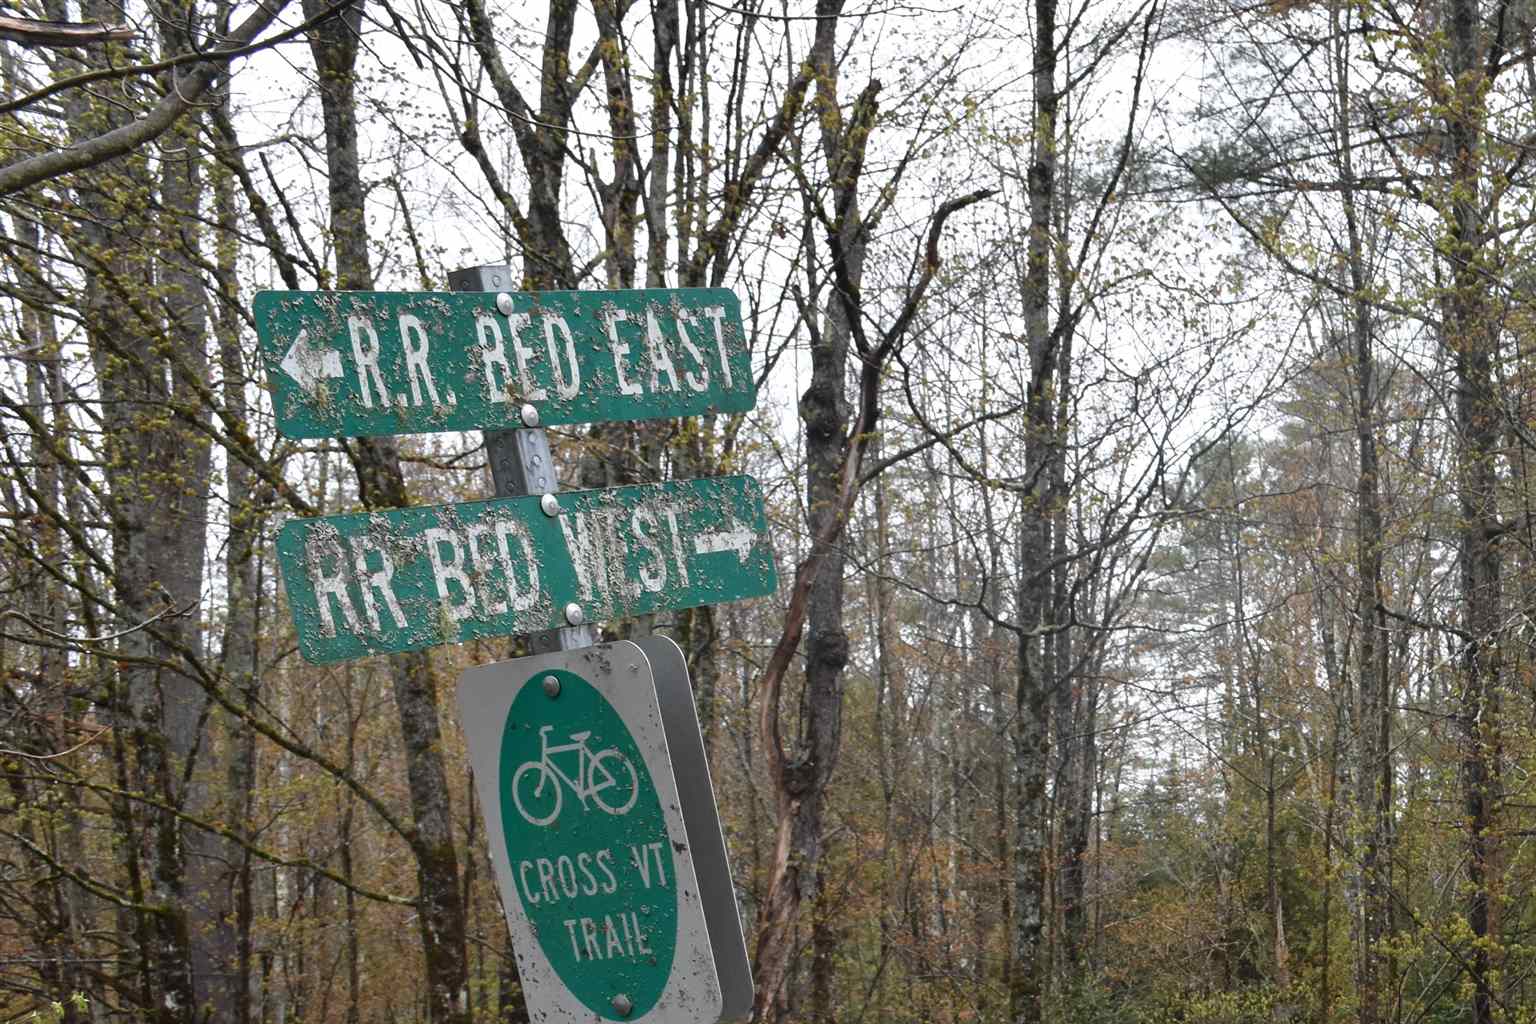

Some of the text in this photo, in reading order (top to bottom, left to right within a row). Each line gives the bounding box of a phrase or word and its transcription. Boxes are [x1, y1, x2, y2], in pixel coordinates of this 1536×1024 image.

[475, 311, 581, 404] BED
[603, 306, 733, 396] EAST
[304, 502, 689, 638] RR BED WEST
[520, 842, 670, 904] CROSS VT
[563, 911, 653, 963] TRAIL
